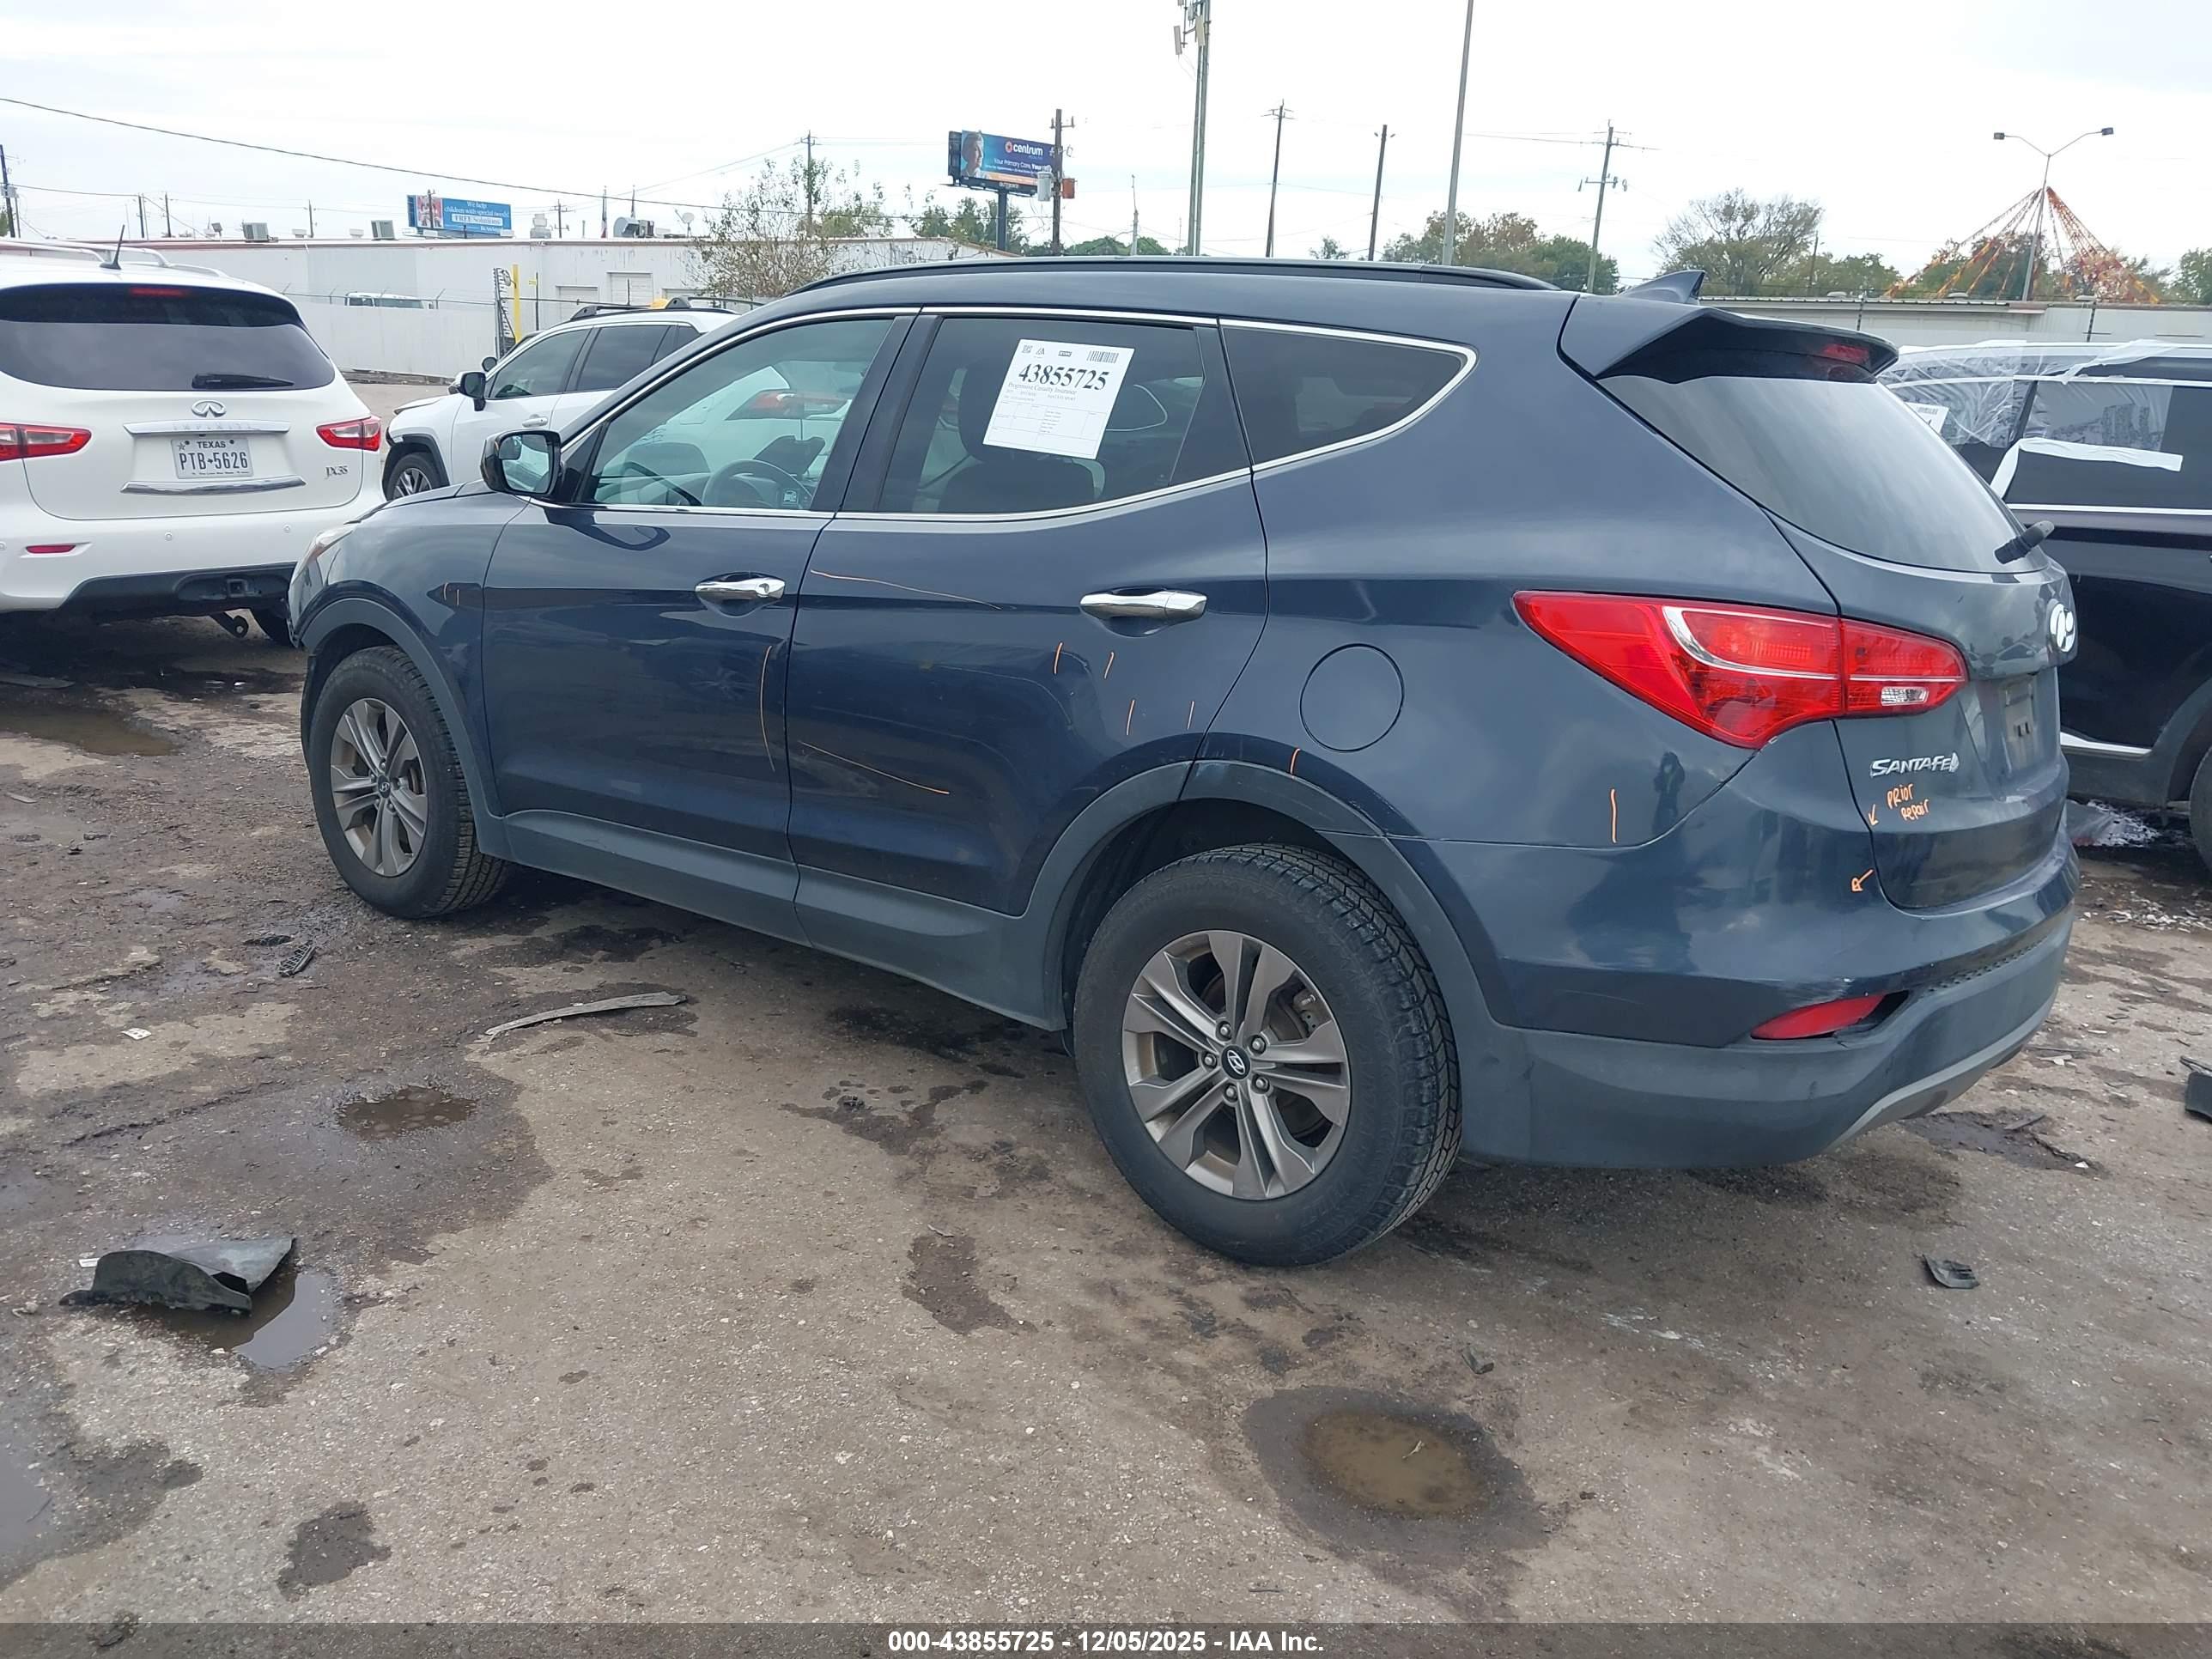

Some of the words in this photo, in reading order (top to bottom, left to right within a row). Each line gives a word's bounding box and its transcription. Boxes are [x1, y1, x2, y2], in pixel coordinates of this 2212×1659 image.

[1013, 143, 1043, 156] centrum
[1018, 363, 1110, 391] 43855725
[197, 441, 226, 449] TEXAS
